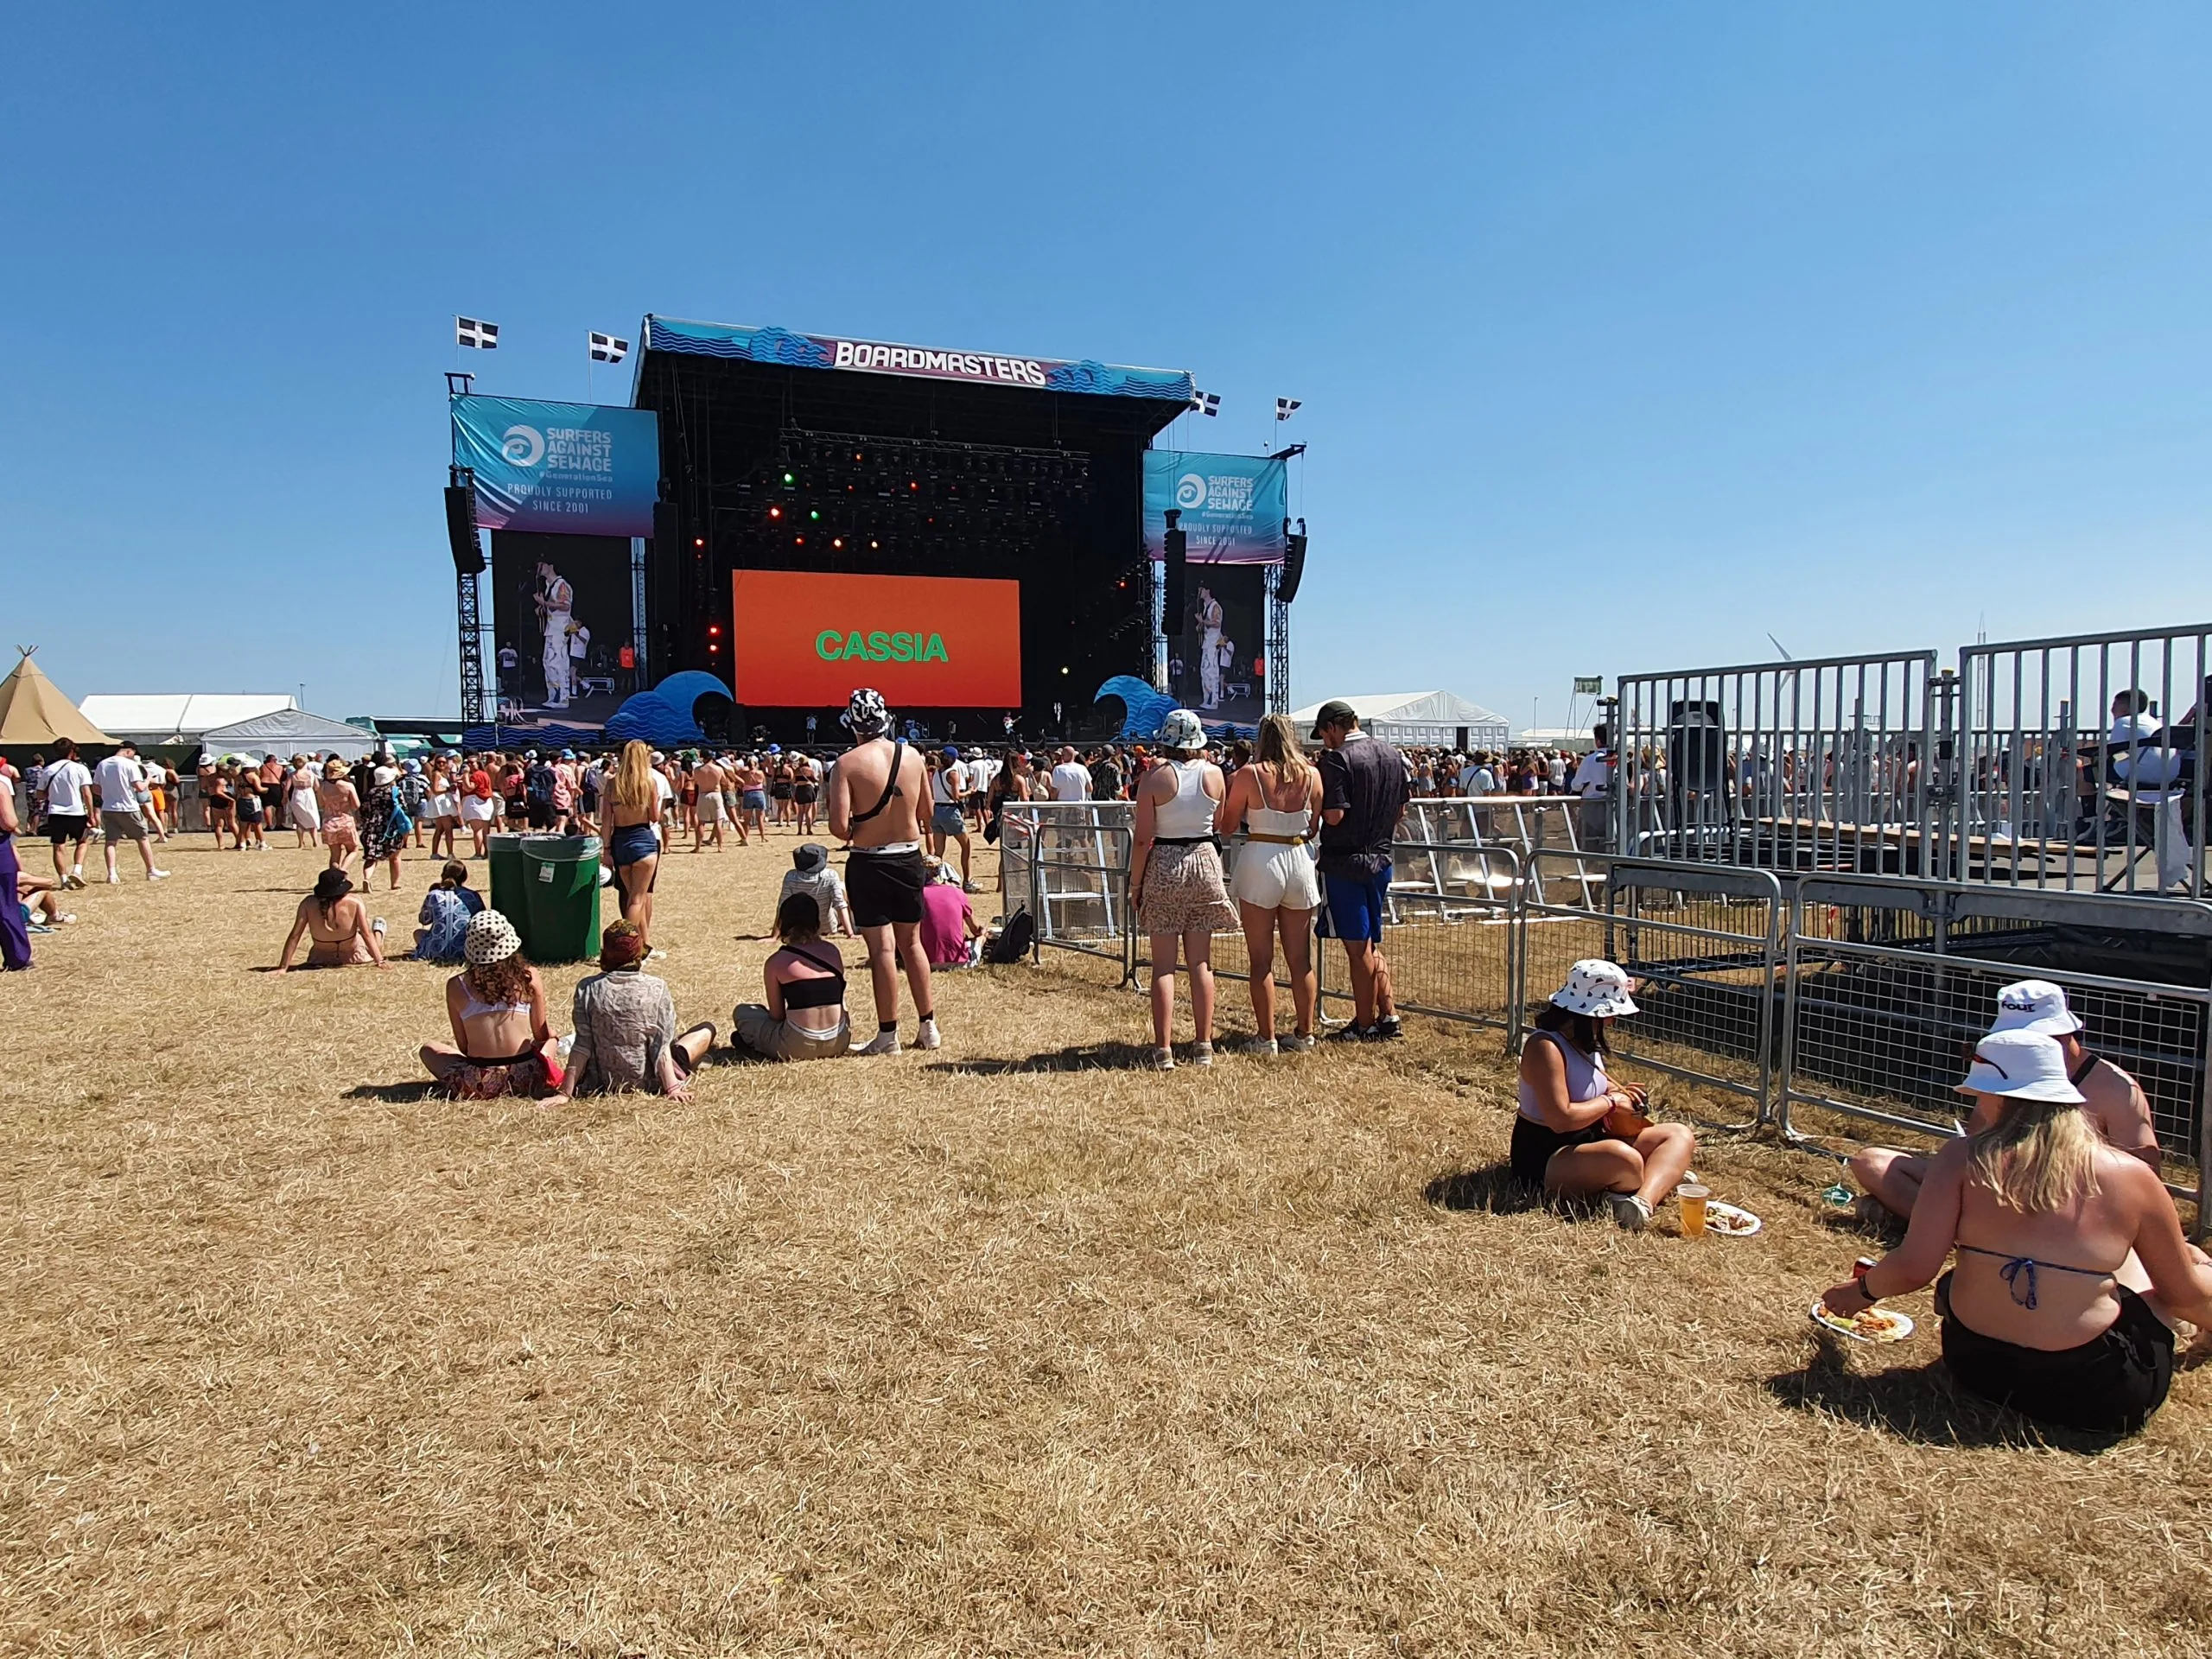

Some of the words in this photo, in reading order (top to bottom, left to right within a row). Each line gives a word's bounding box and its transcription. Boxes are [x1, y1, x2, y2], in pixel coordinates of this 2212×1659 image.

[835, 341, 1046, 386] BOARDMASTERS
[546, 427, 613, 444] SURFERS
[547, 441, 613, 458] AGAINST
[547, 454, 613, 472] SEWAGE
[1208, 475, 1254, 488] SURFERS
[507, 483, 552, 497] PROUDLY
[556, 486, 613, 499] SUPPORTED
[1208, 486, 1253, 499] AGAINST
[532, 500, 562, 512] SINCE
[566, 503, 588, 514] 2001
[1208, 498, 1253, 512] SEWAGE
[1196, 536, 1216, 545] SINCE
[816, 629, 949, 663] CASSIA
